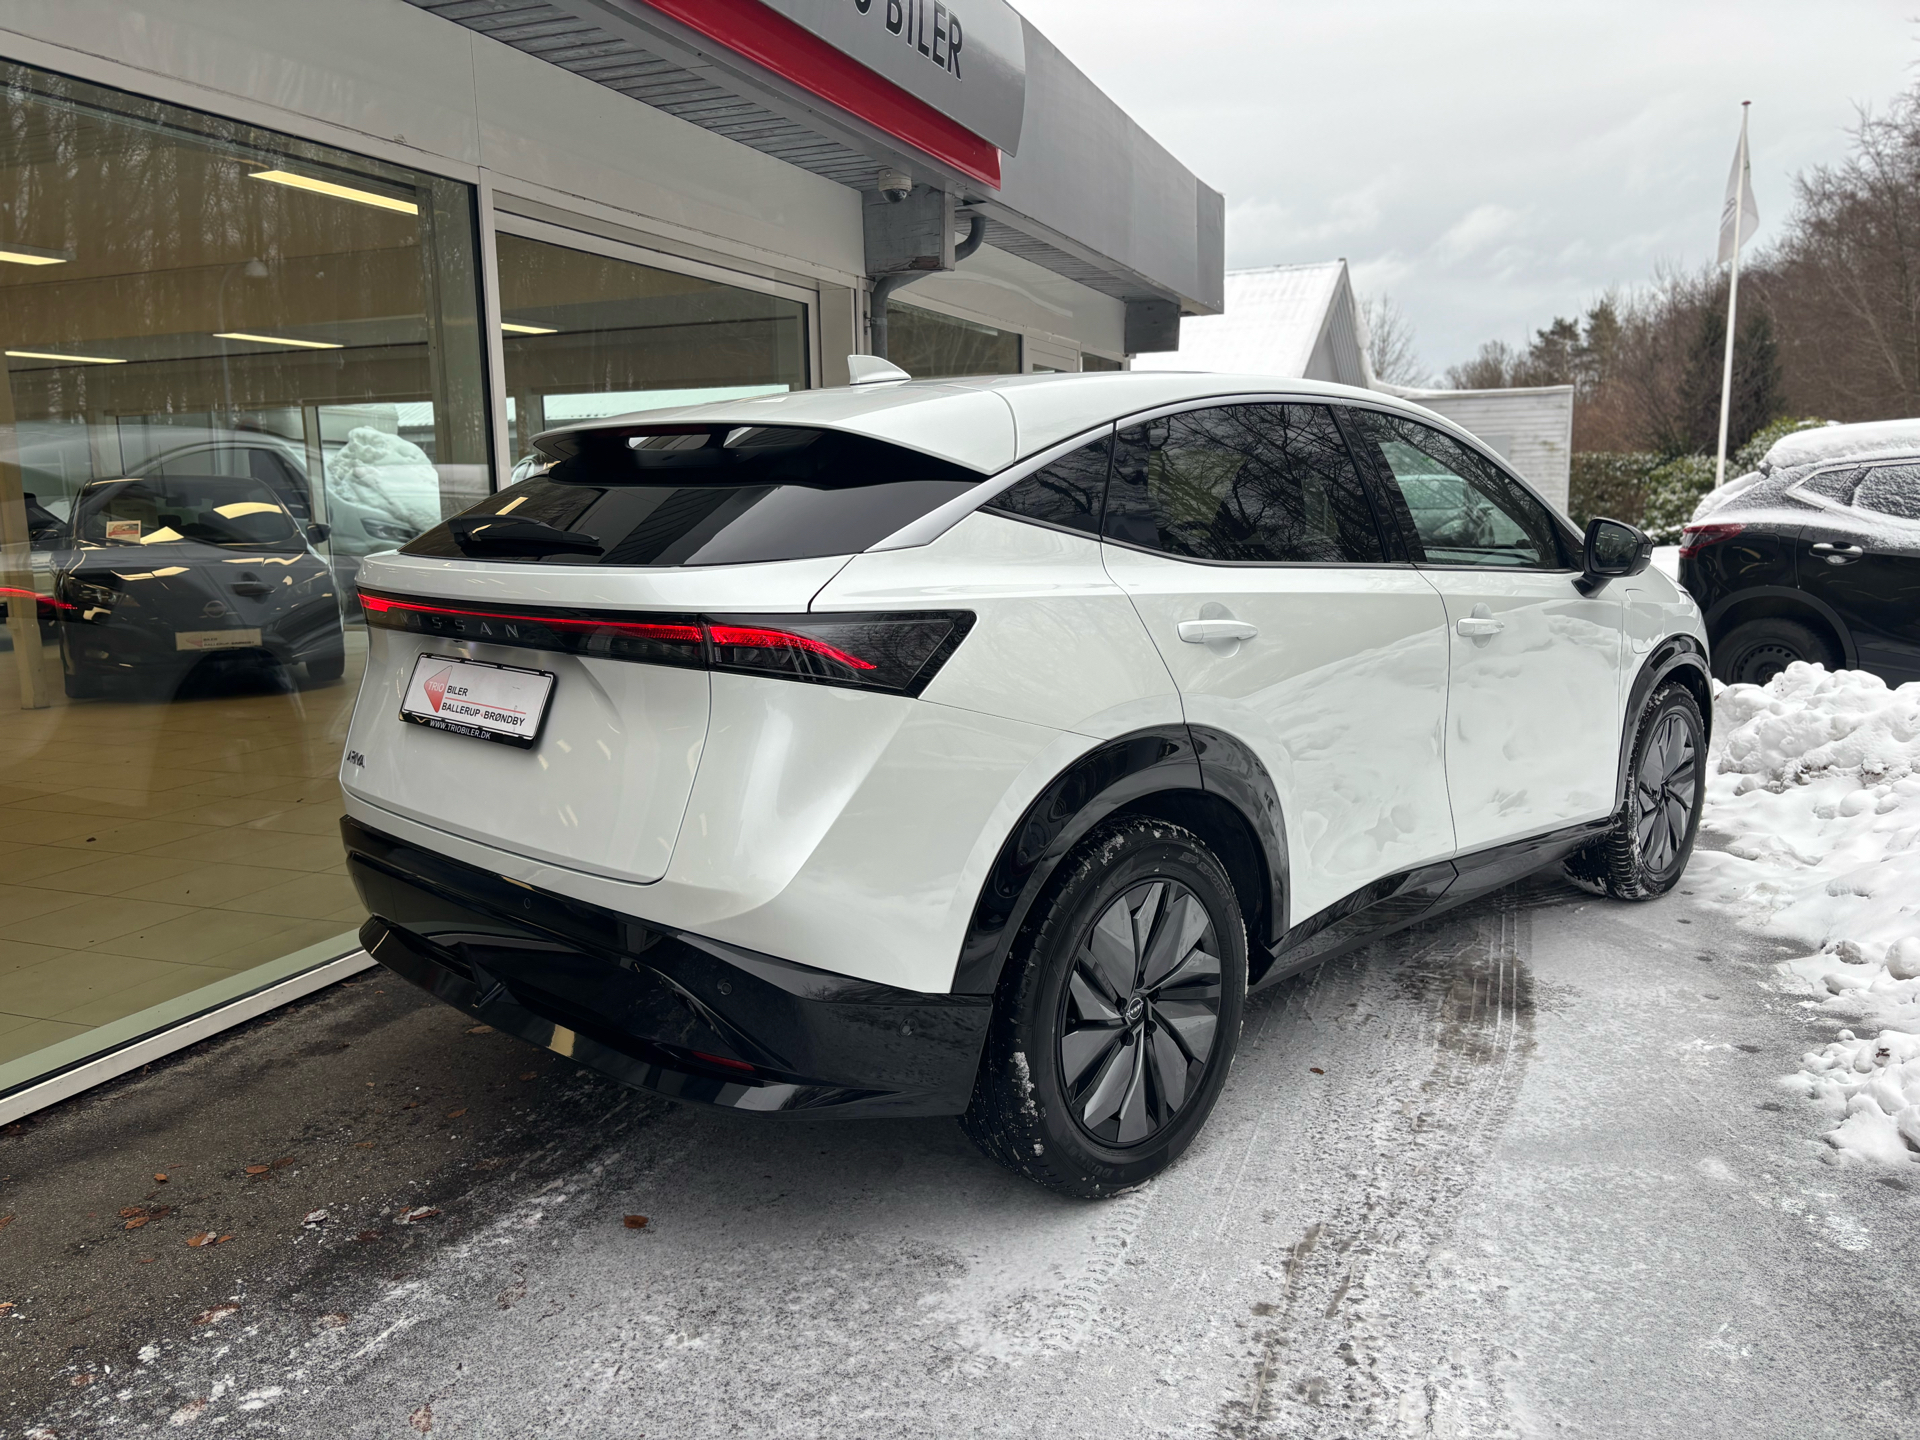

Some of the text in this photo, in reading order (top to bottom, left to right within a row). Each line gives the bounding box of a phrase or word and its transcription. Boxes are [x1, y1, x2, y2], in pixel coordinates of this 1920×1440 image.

[400, 611, 519, 638] NISSAN
[428, 680, 468, 697] TRIO BILER
[441, 702, 481, 718] BALLERUP
[429, 719, 492, 740] WWW.TRIOBILER.DK
